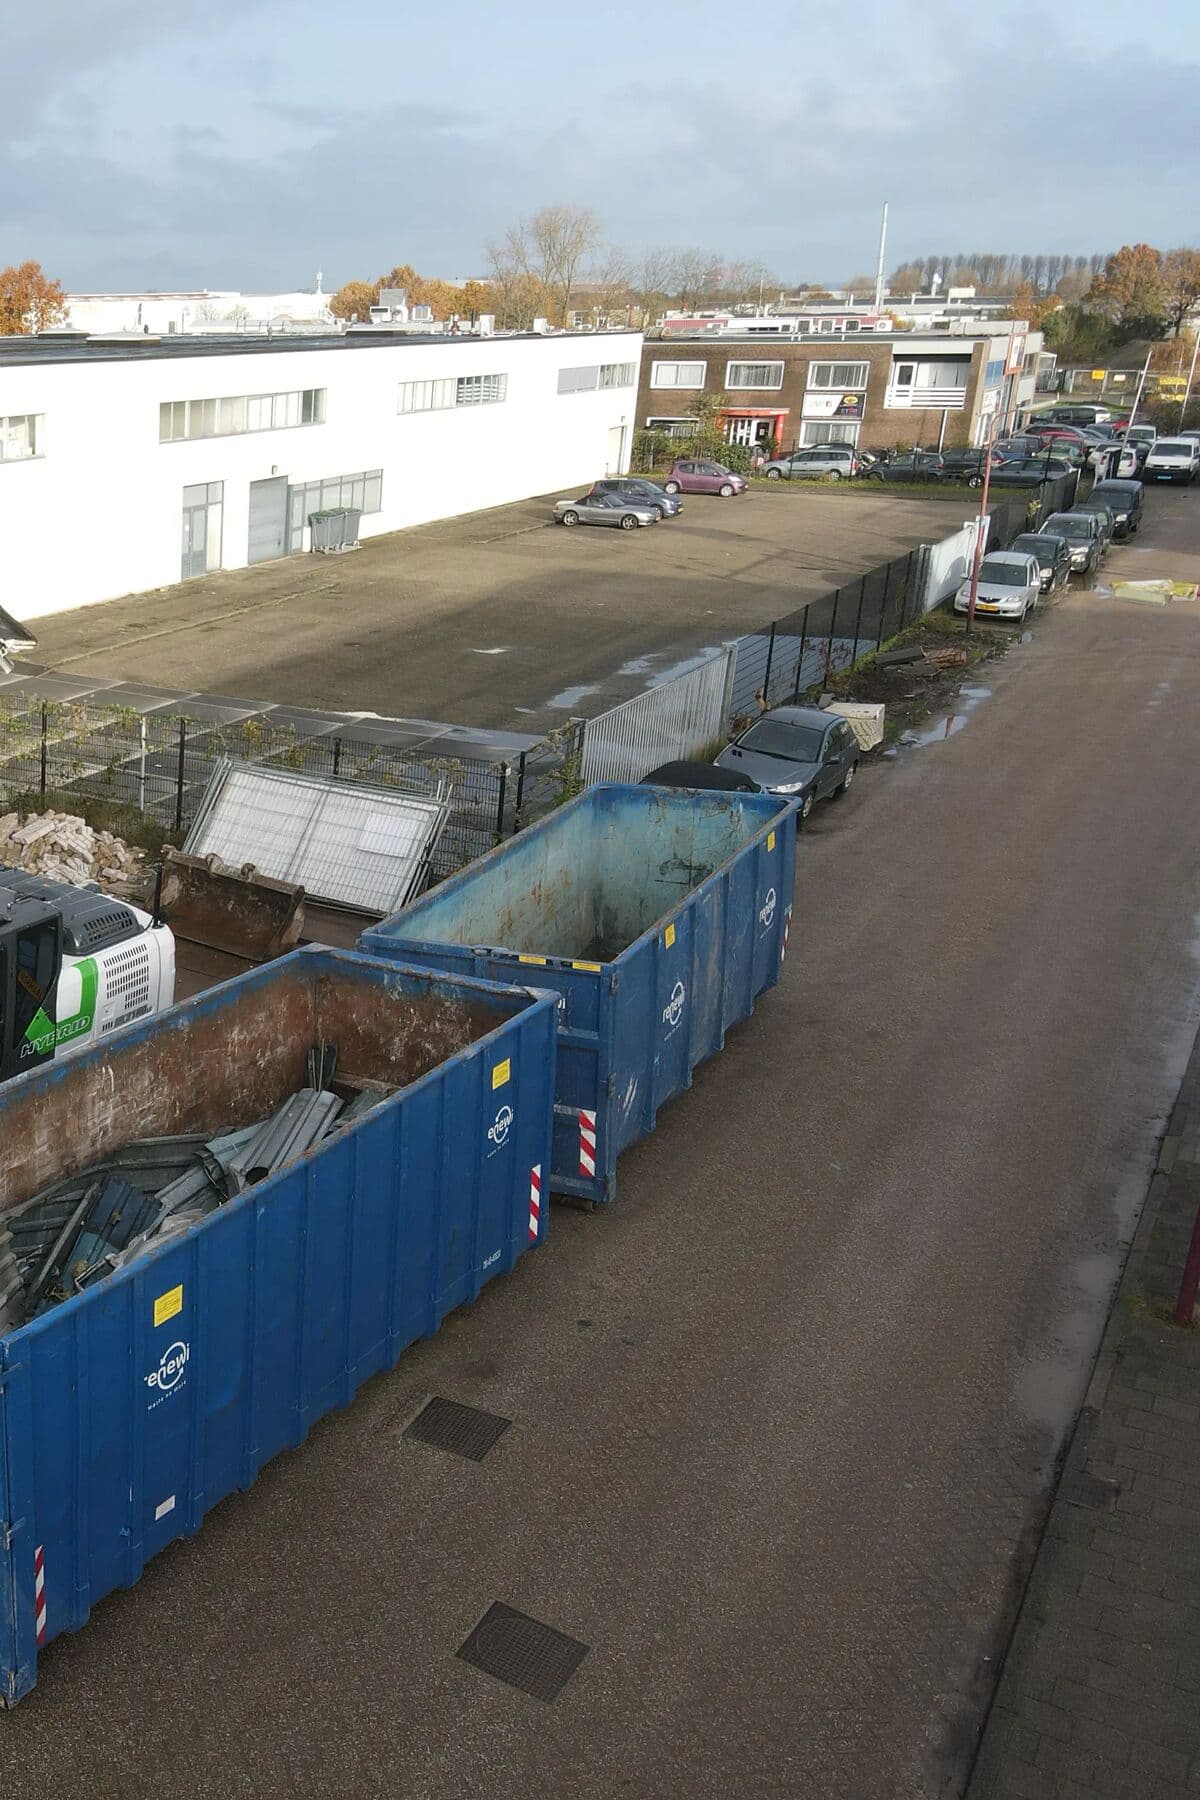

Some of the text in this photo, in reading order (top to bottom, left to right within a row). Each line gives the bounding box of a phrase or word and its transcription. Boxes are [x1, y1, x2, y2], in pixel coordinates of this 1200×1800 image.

[20, 1016, 90, 1059] HYBRID
[488, 1108, 514, 1140] enewi
[144, 1342, 190, 1387] enewi
